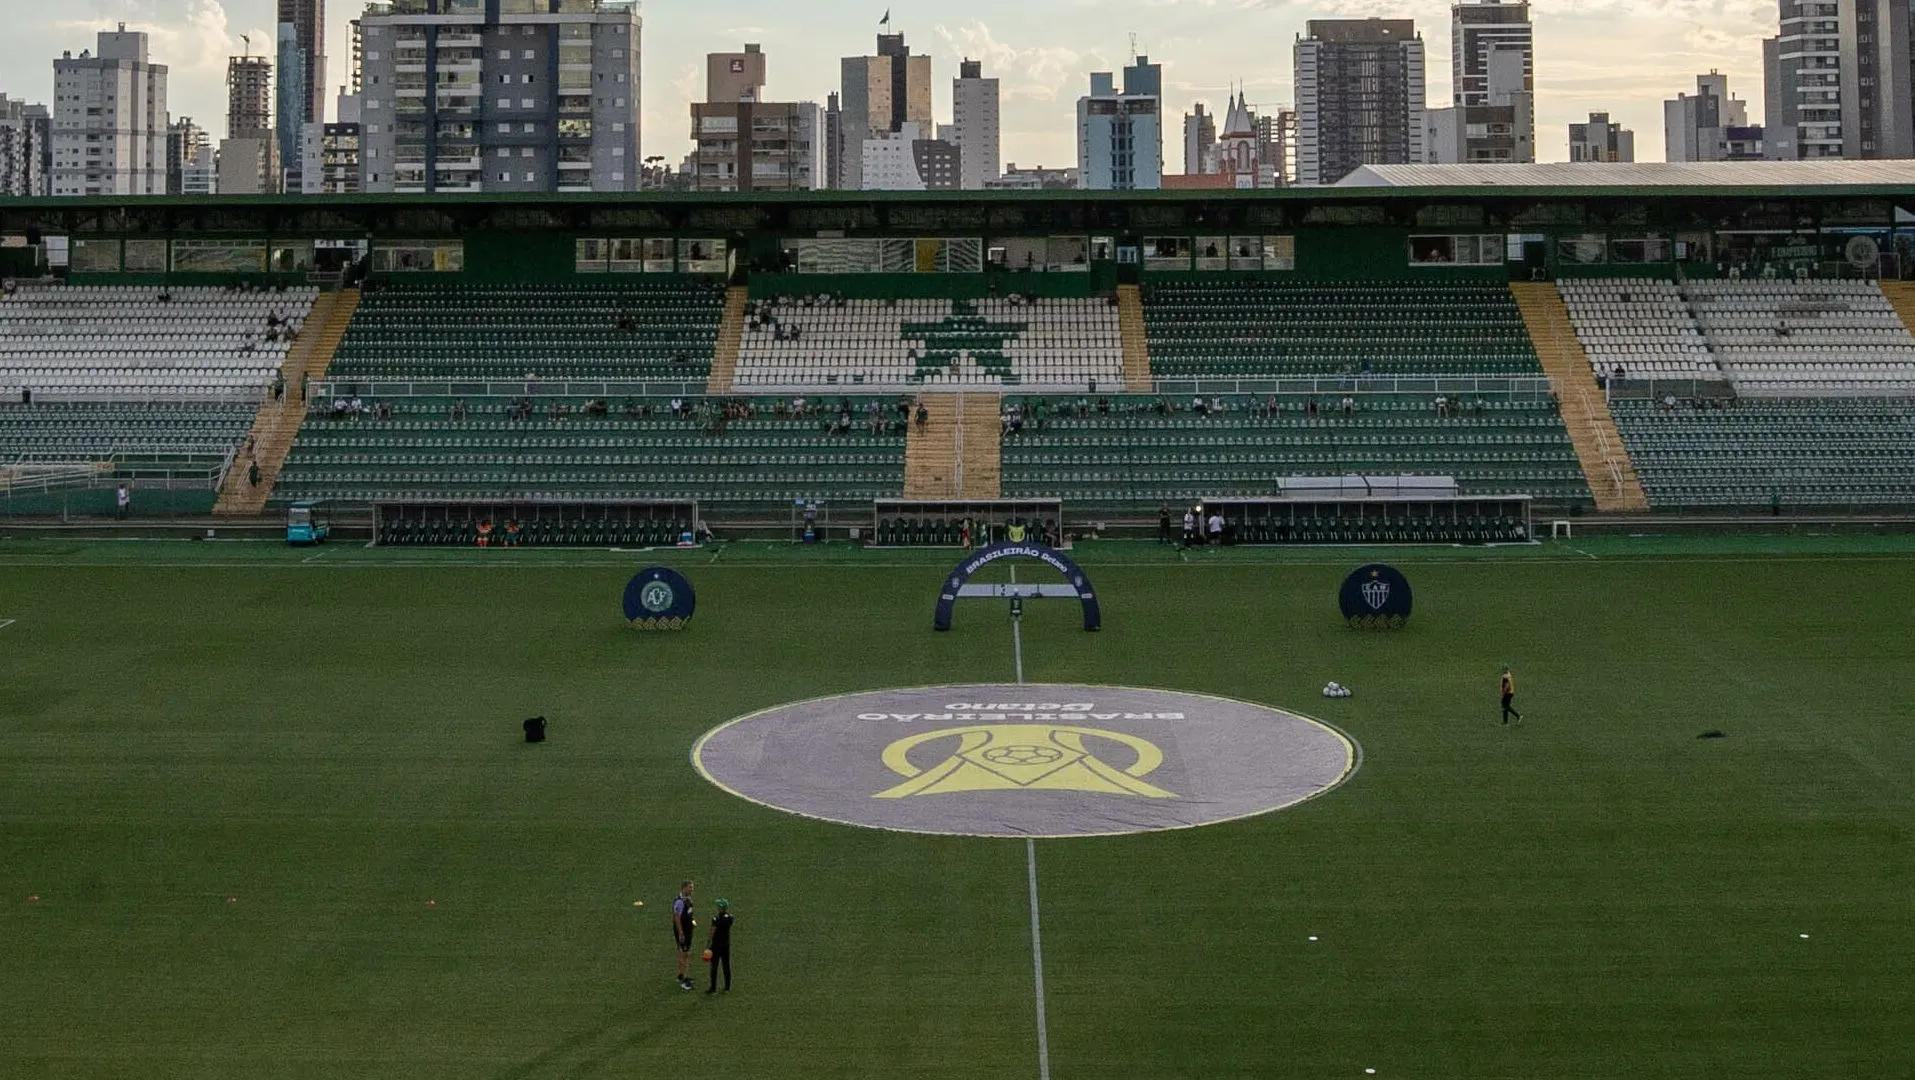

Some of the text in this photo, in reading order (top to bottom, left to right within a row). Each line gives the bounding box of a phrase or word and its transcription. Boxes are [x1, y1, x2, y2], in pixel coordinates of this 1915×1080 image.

[966, 547, 1039, 574] BRASILEIRÃO
[945, 702, 1095, 711] Betano
[857, 711, 1186, 722] BRASILEIRÃO
